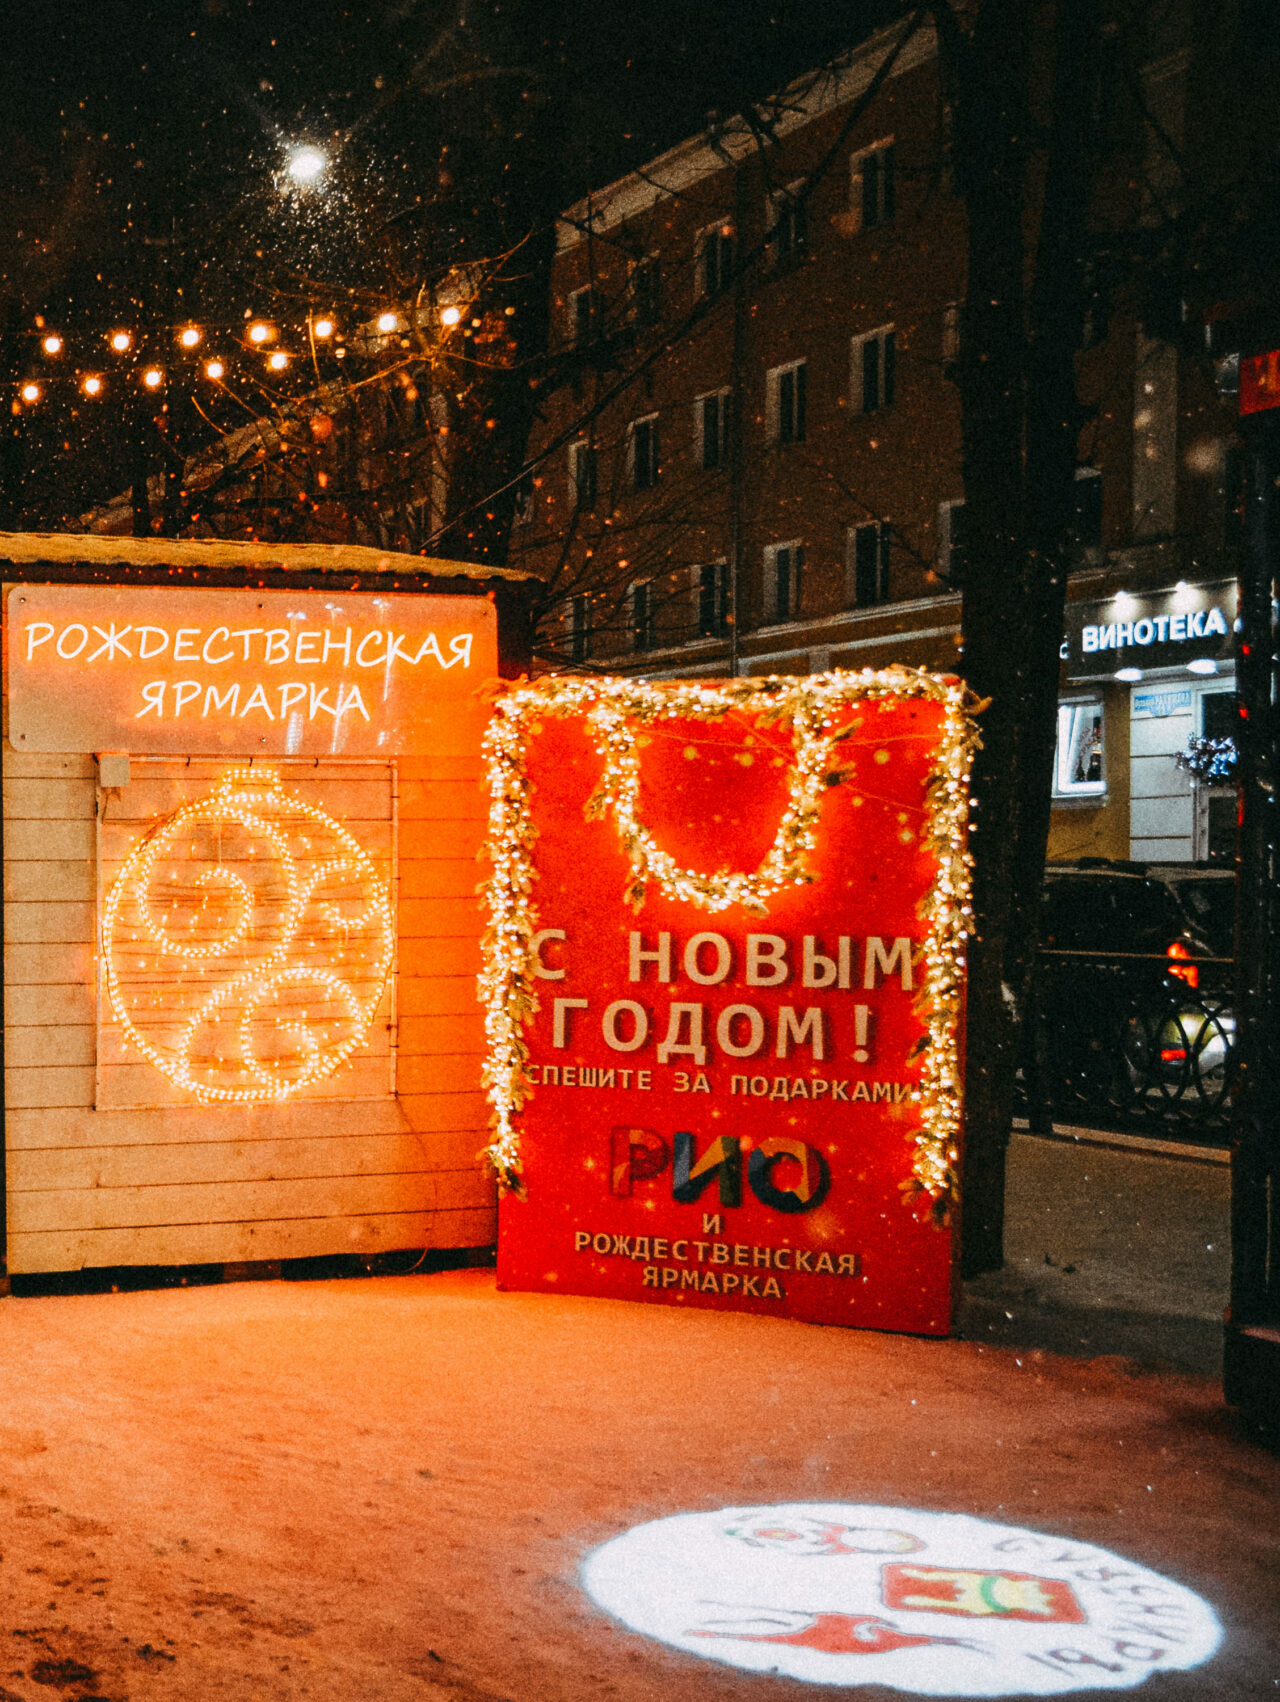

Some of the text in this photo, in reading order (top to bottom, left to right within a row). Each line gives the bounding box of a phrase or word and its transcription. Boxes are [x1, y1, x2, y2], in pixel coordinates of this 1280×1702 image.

[24, 621, 474, 669] РОЖДЕСТВЕНСКАЯ
[1081, 606, 1228, 654] ВИНОТЕКА
[135, 680, 371, 722] ЯРМАРКА
[528, 928, 914, 991] С НОВЫМ
[527, 1064, 918, 1103] СПЕШИТЕ ЗА ПОДАРКАМИ
[610, 1126, 832, 1214] РИО
[702, 1212, 722, 1235] И
[574, 1230, 857, 1277] РОЖДЕСТВЕНСКАЯ
[641, 1265, 783, 1299] ЯРМАРКА
